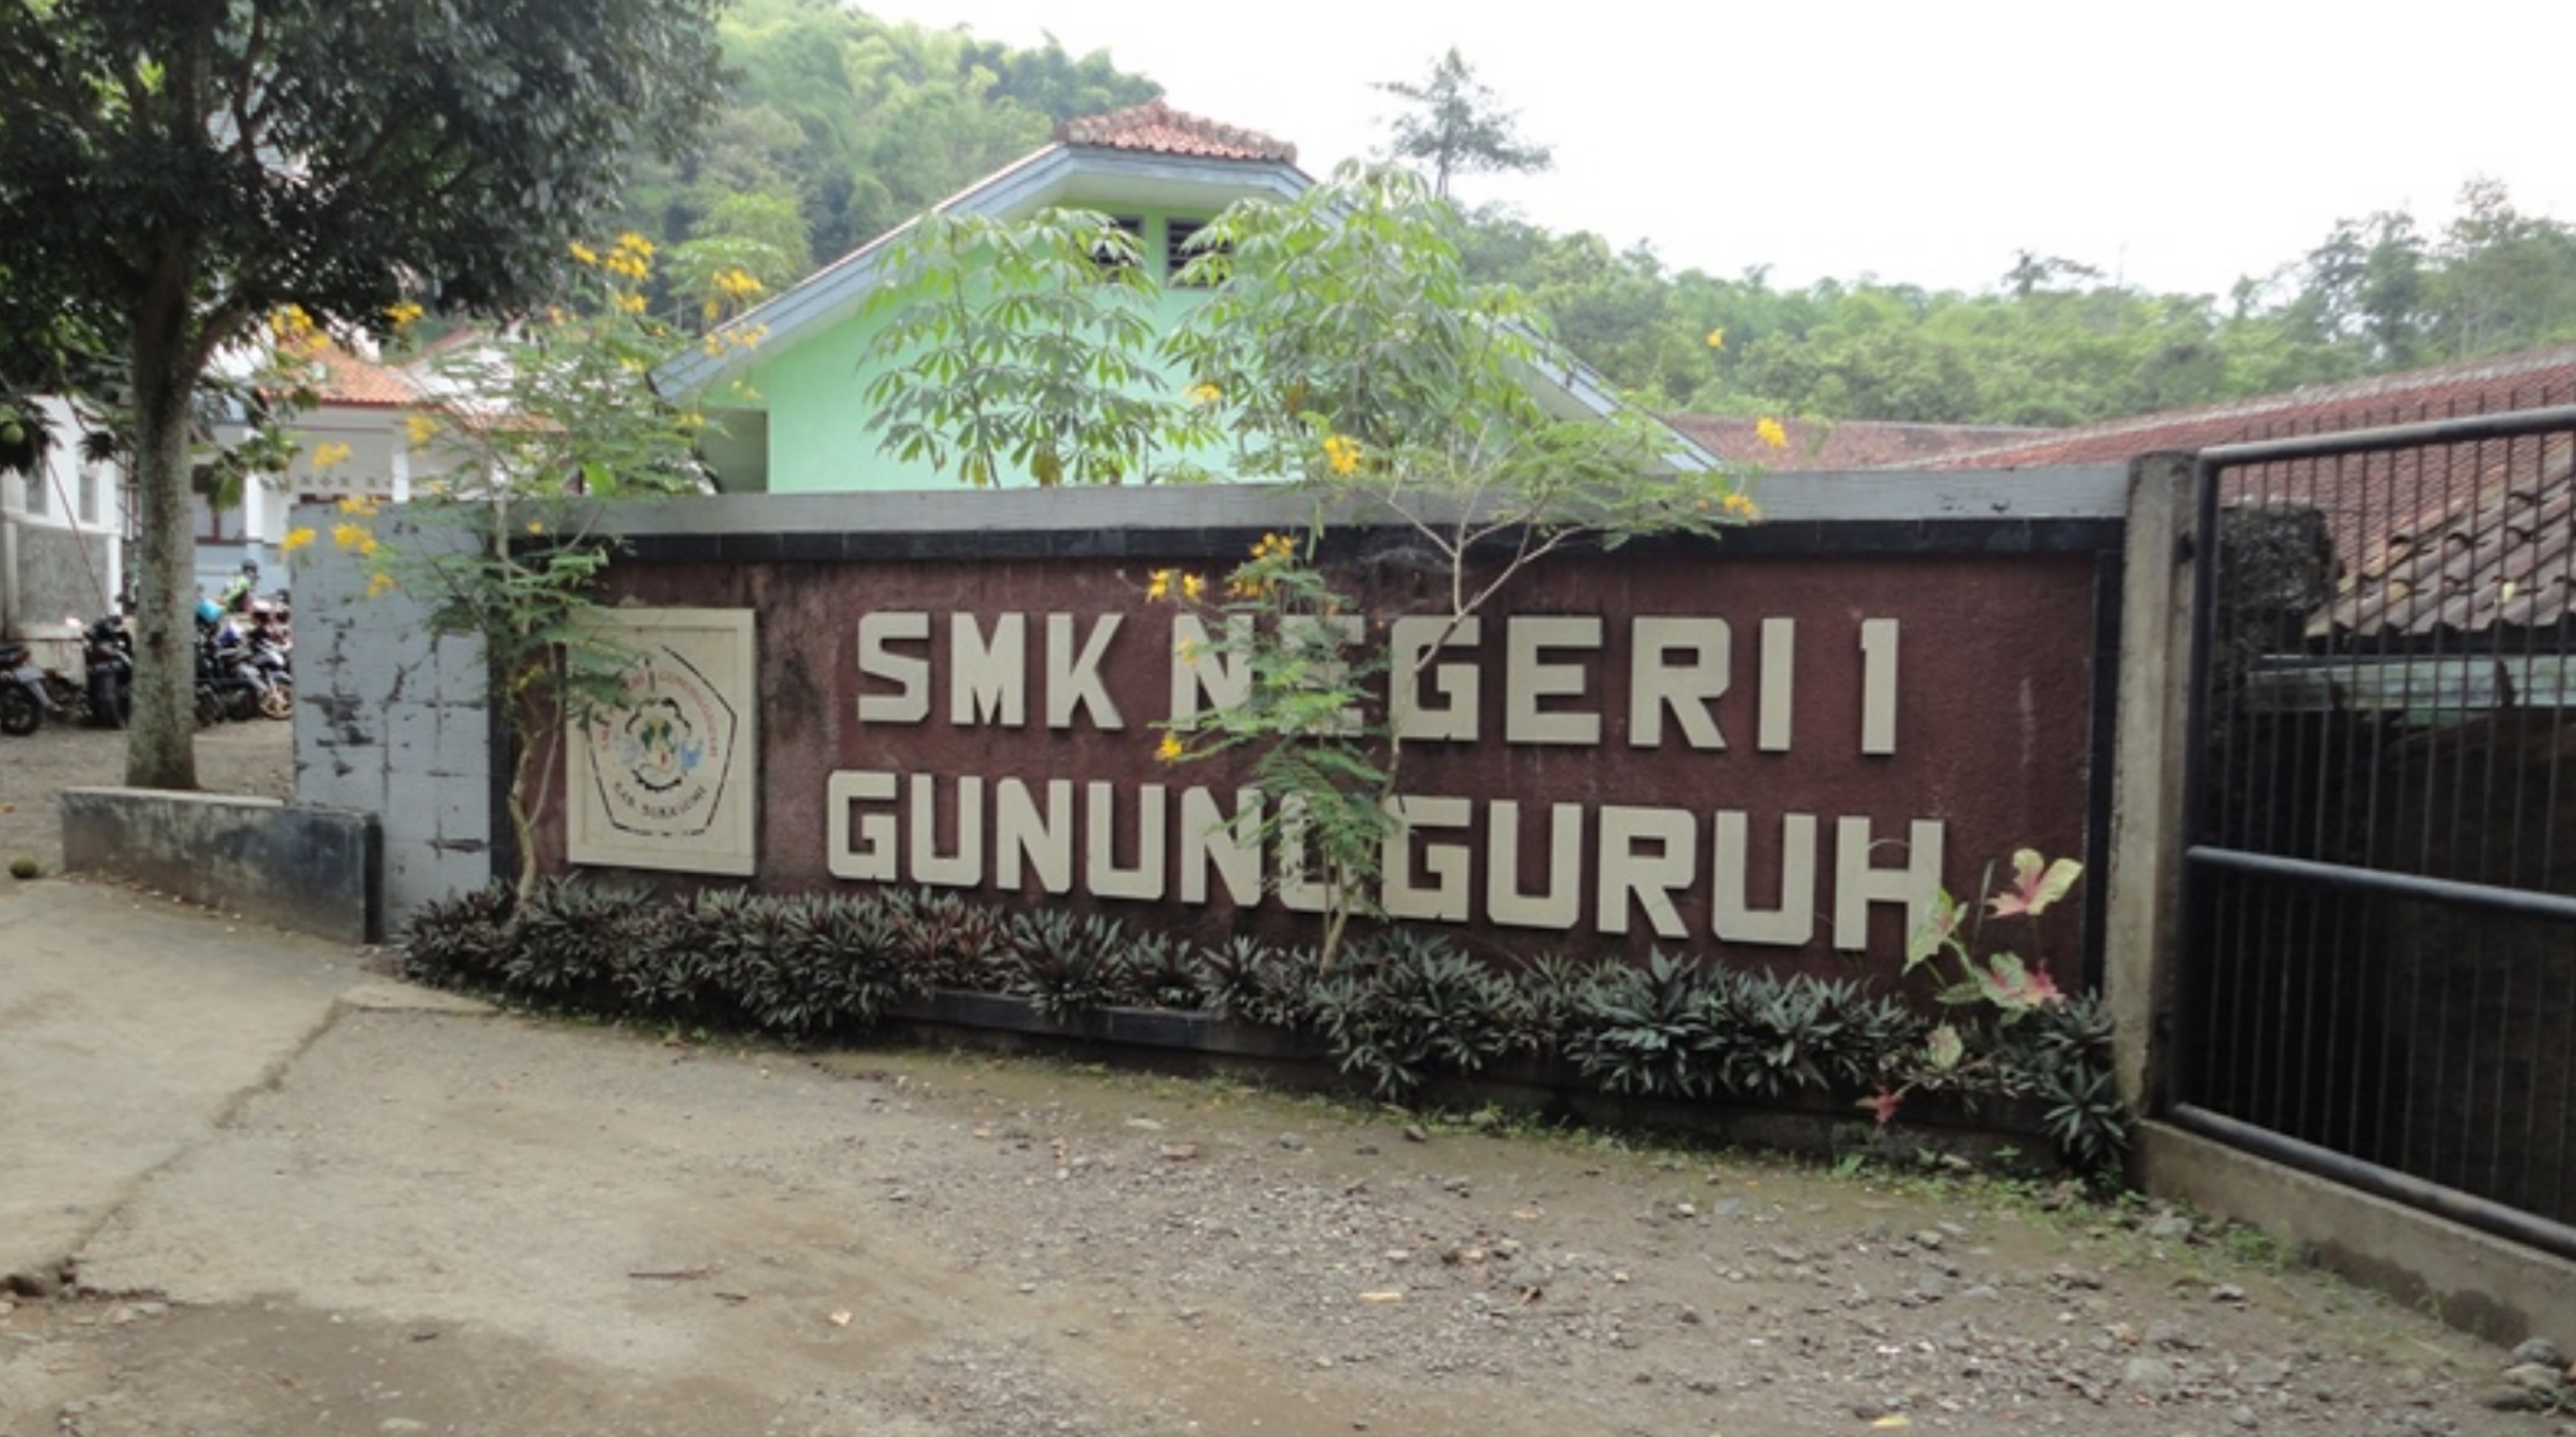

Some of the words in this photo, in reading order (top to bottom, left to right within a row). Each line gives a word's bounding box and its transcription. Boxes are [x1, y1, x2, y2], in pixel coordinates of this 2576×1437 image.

[858, 612, 1125, 728] SMK
[1170, 613, 1795, 751] NEGERI
[1861, 618, 1900, 755] 1
